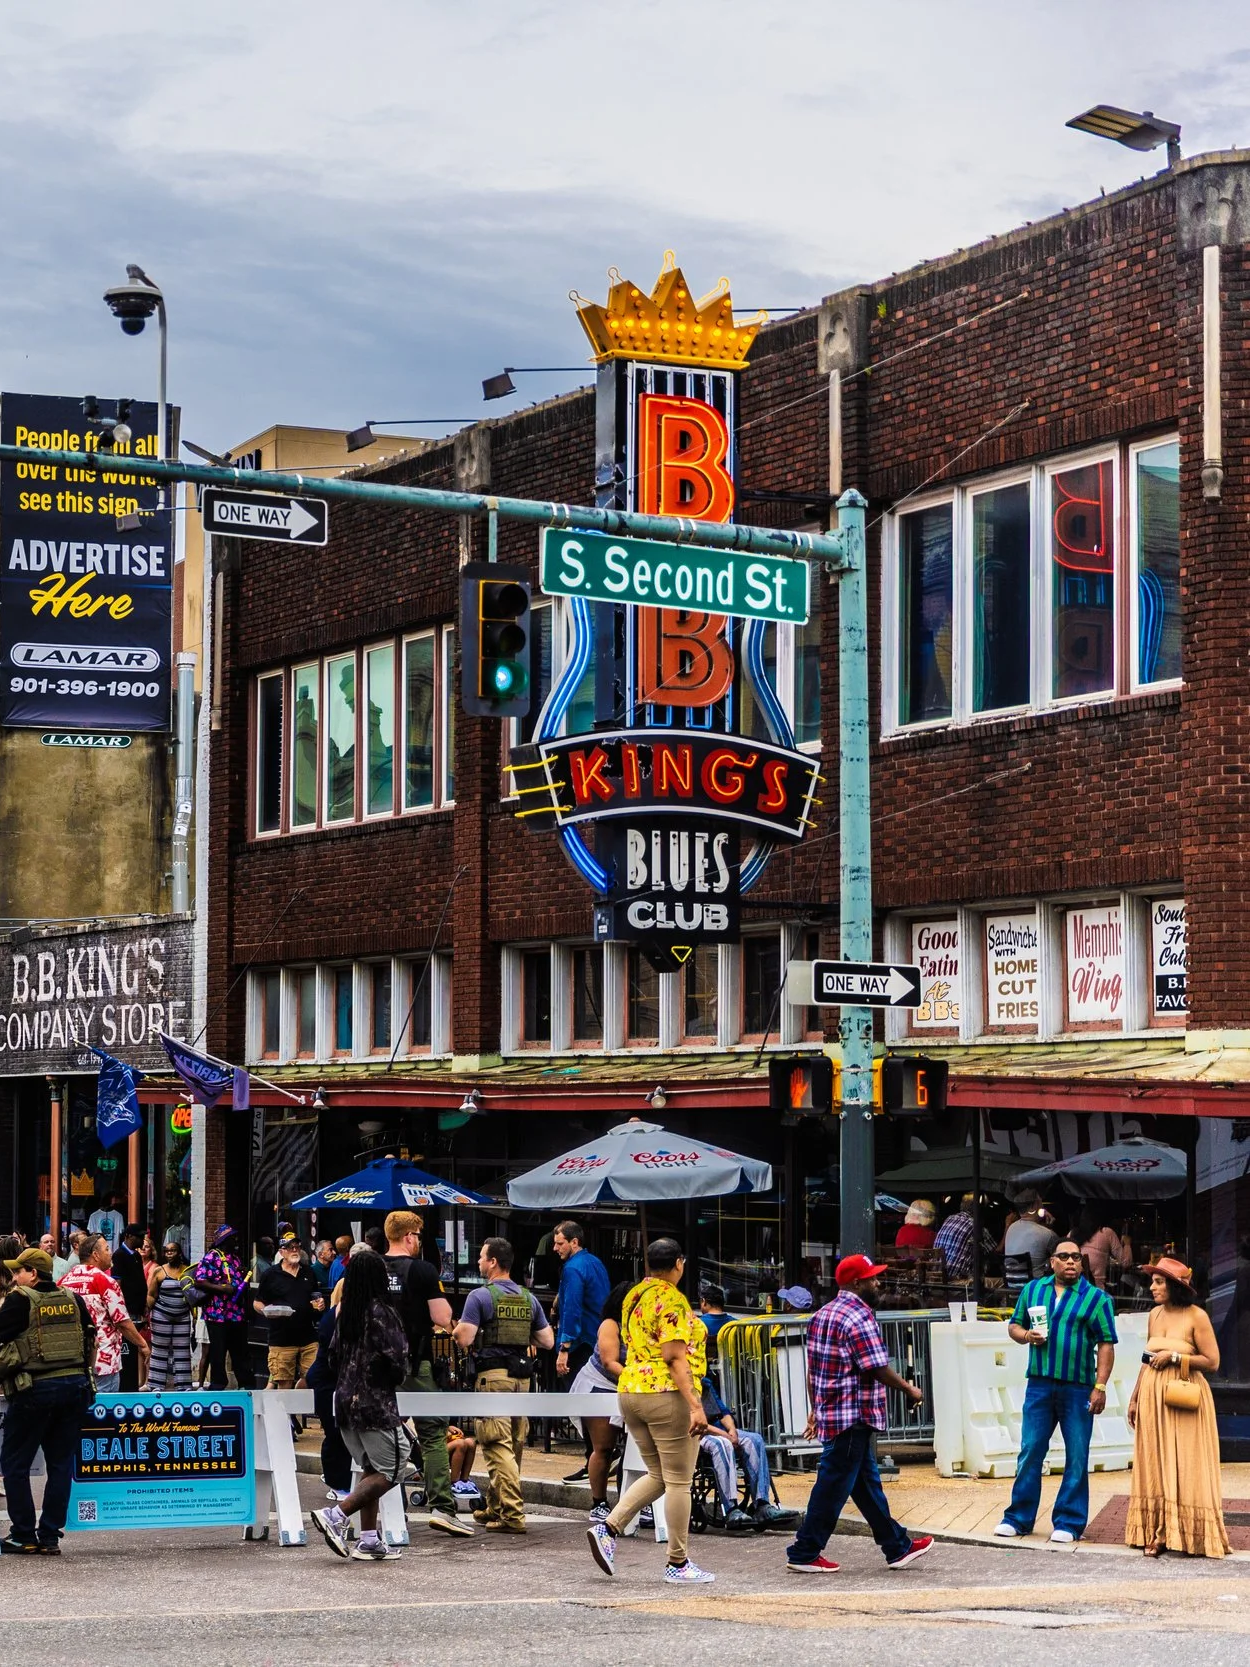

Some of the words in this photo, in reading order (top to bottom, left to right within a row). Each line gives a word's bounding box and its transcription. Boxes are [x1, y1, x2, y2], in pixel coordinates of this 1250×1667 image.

[15, 426, 81, 451] People
[85, 431, 131, 455] frm
[135, 434, 159, 457] all
[16, 462, 58, 480] over
[19, 491, 52, 511] see
[56, 490, 94, 514] this
[218, 503, 251, 522] ONE
[257, 507, 291, 526] WAY
[8, 538, 165, 577] ADVERTISE
[559, 540, 592, 589] S.
[603, 545, 735, 606] Second
[744, 563, 795, 614] St.
[29, 571, 135, 620] Here
[22, 648, 148, 667] LAMAR
[10, 677, 160, 698] 901-396-1900
[49, 735, 123, 746] LAMAR
[568, 741, 790, 815] KING'S
[626, 828, 731, 894] BLUES
[626, 901, 730, 932] CLUB
[995, 949, 1016, 957] WITH
[1160, 947, 1186, 968] Cat
[12, 951, 62, 1004] B.B.
[66, 937, 165, 999] KING'S
[995, 959, 1037, 975] HOME
[825, 975, 854, 992] ONE
[860, 977, 889, 994] WAY
[924, 980, 951, 1003] At
[998, 979, 1037, 995] CUT
[1072, 962, 1122, 1012] Wing
[1168, 978, 1187, 989] B.
[997, 1001, 1038, 1018] FRIES
[102, 1002, 186, 1046] STORE
[917, 1070, 928, 1106] 6
[172, 1107, 192, 1128] OPE
[557, 1156, 611, 1170] Coors
[630, 1151, 702, 1164] Coors
[644, 1160, 697, 1169] LIGHT
[551, 1167, 595, 1176] LIGHT
[347, 1197, 375, 1205] TIME
[40, 1304, 74, 1317] POLICE
[498, 1306, 531, 1319] POLICE
[95, 1404, 220, 1417] WELCOME
[118, 1423, 127, 1433] To
[130, 1423, 143, 1433] The
[145, 1422, 169, 1433] World
[172, 1422, 200, 1433] Famous
[81, 1437, 149, 1461] BEALE
[157, 1435, 236, 1459] STREET
[81, 1464, 151, 1473] MEMPHIS,
[155, 1462, 237, 1472] TENNESSEE
